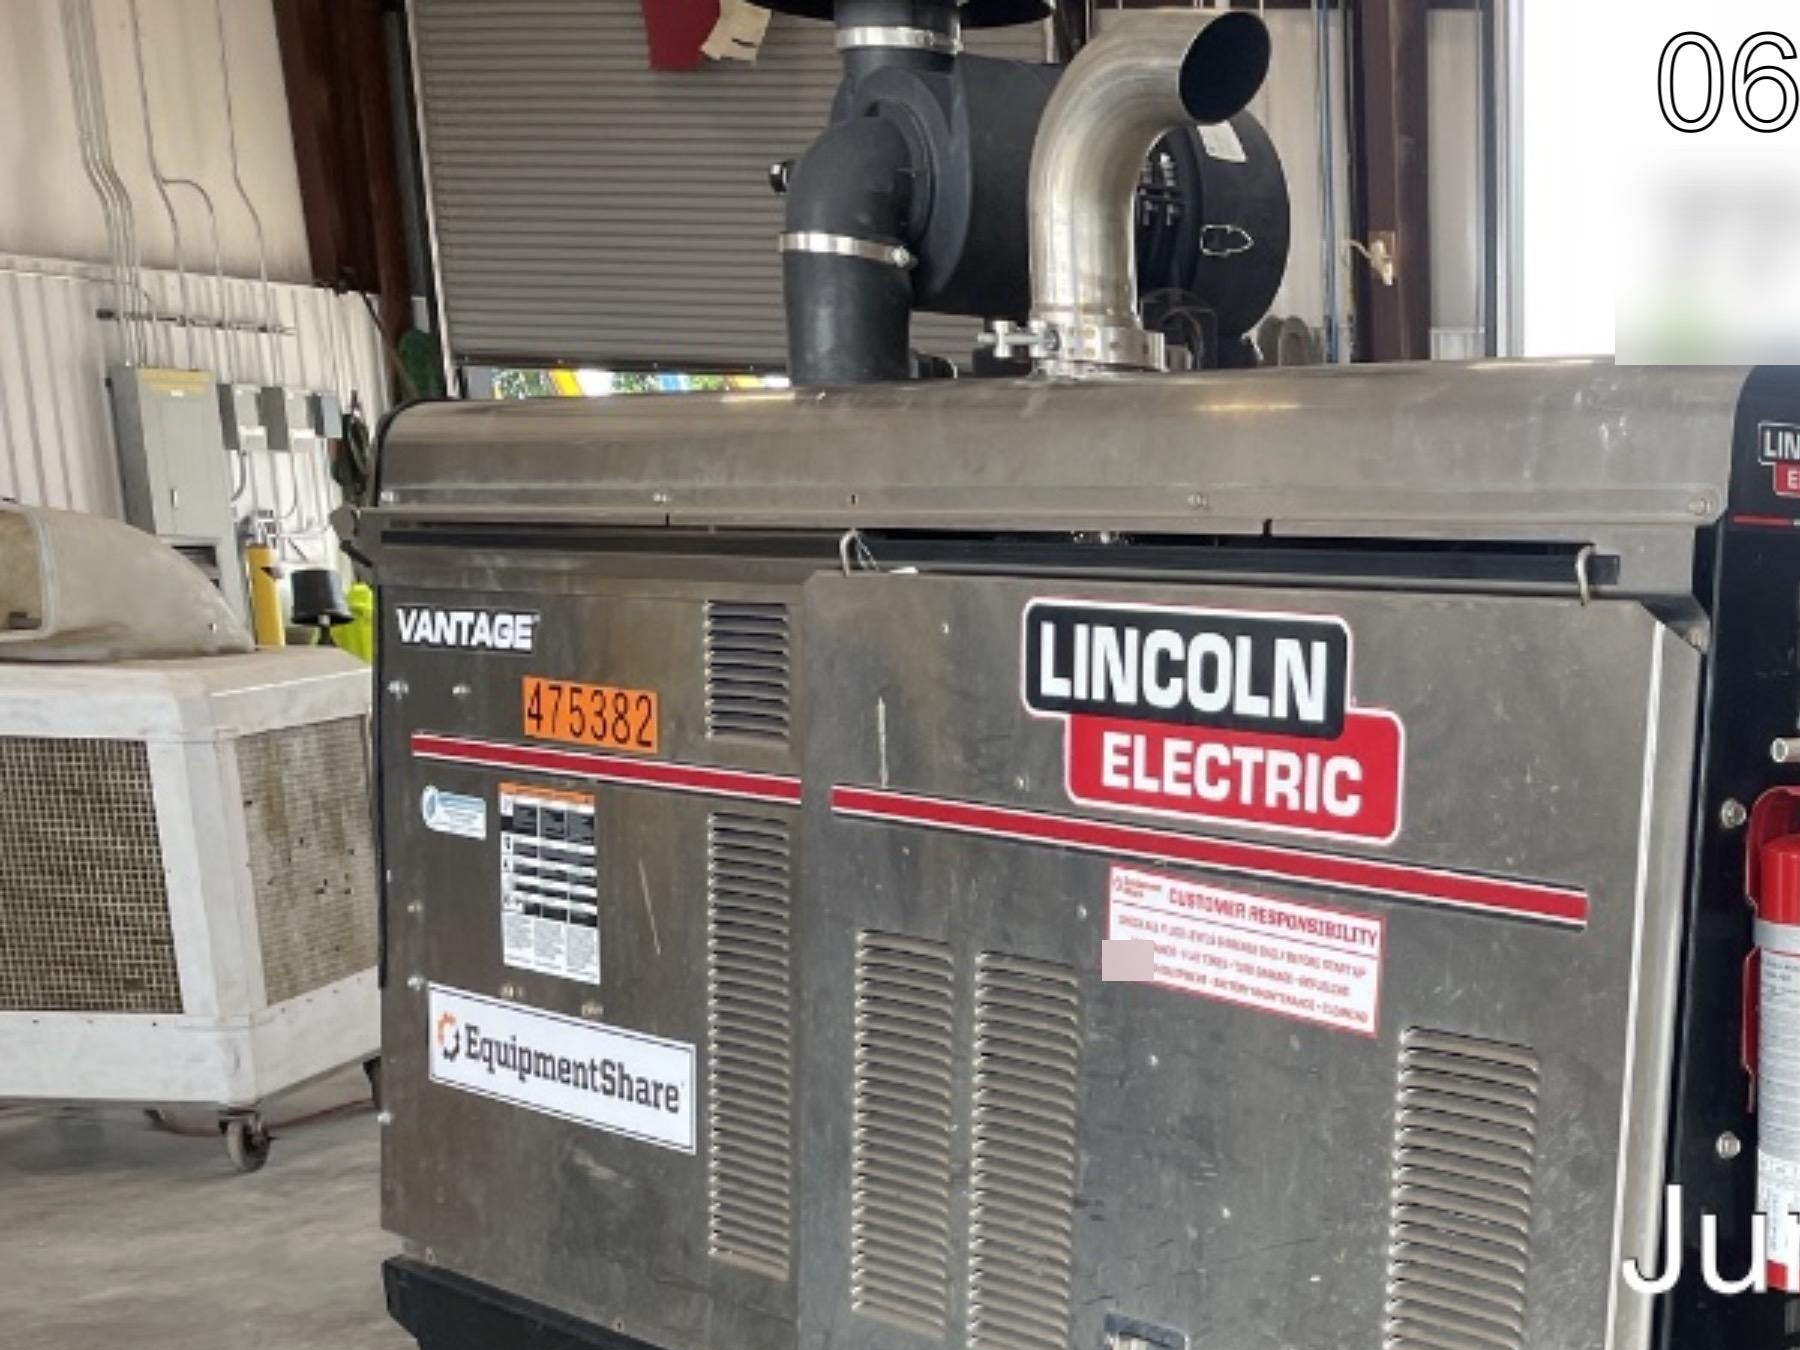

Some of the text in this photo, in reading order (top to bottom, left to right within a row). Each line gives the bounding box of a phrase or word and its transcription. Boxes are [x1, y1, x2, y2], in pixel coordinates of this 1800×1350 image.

[396, 607, 534, 651] VANTAGE
[1039, 621, 1328, 723] LINCOLN
[527, 681, 653, 748] 475382
[1101, 731, 1363, 818] ELECTRIC
[1169, 886, 1247, 919] CUSTOMER
[1249, 906, 1378, 947] RESPONSIBILITY
[464, 1022, 680, 1114] EquipmentShare
